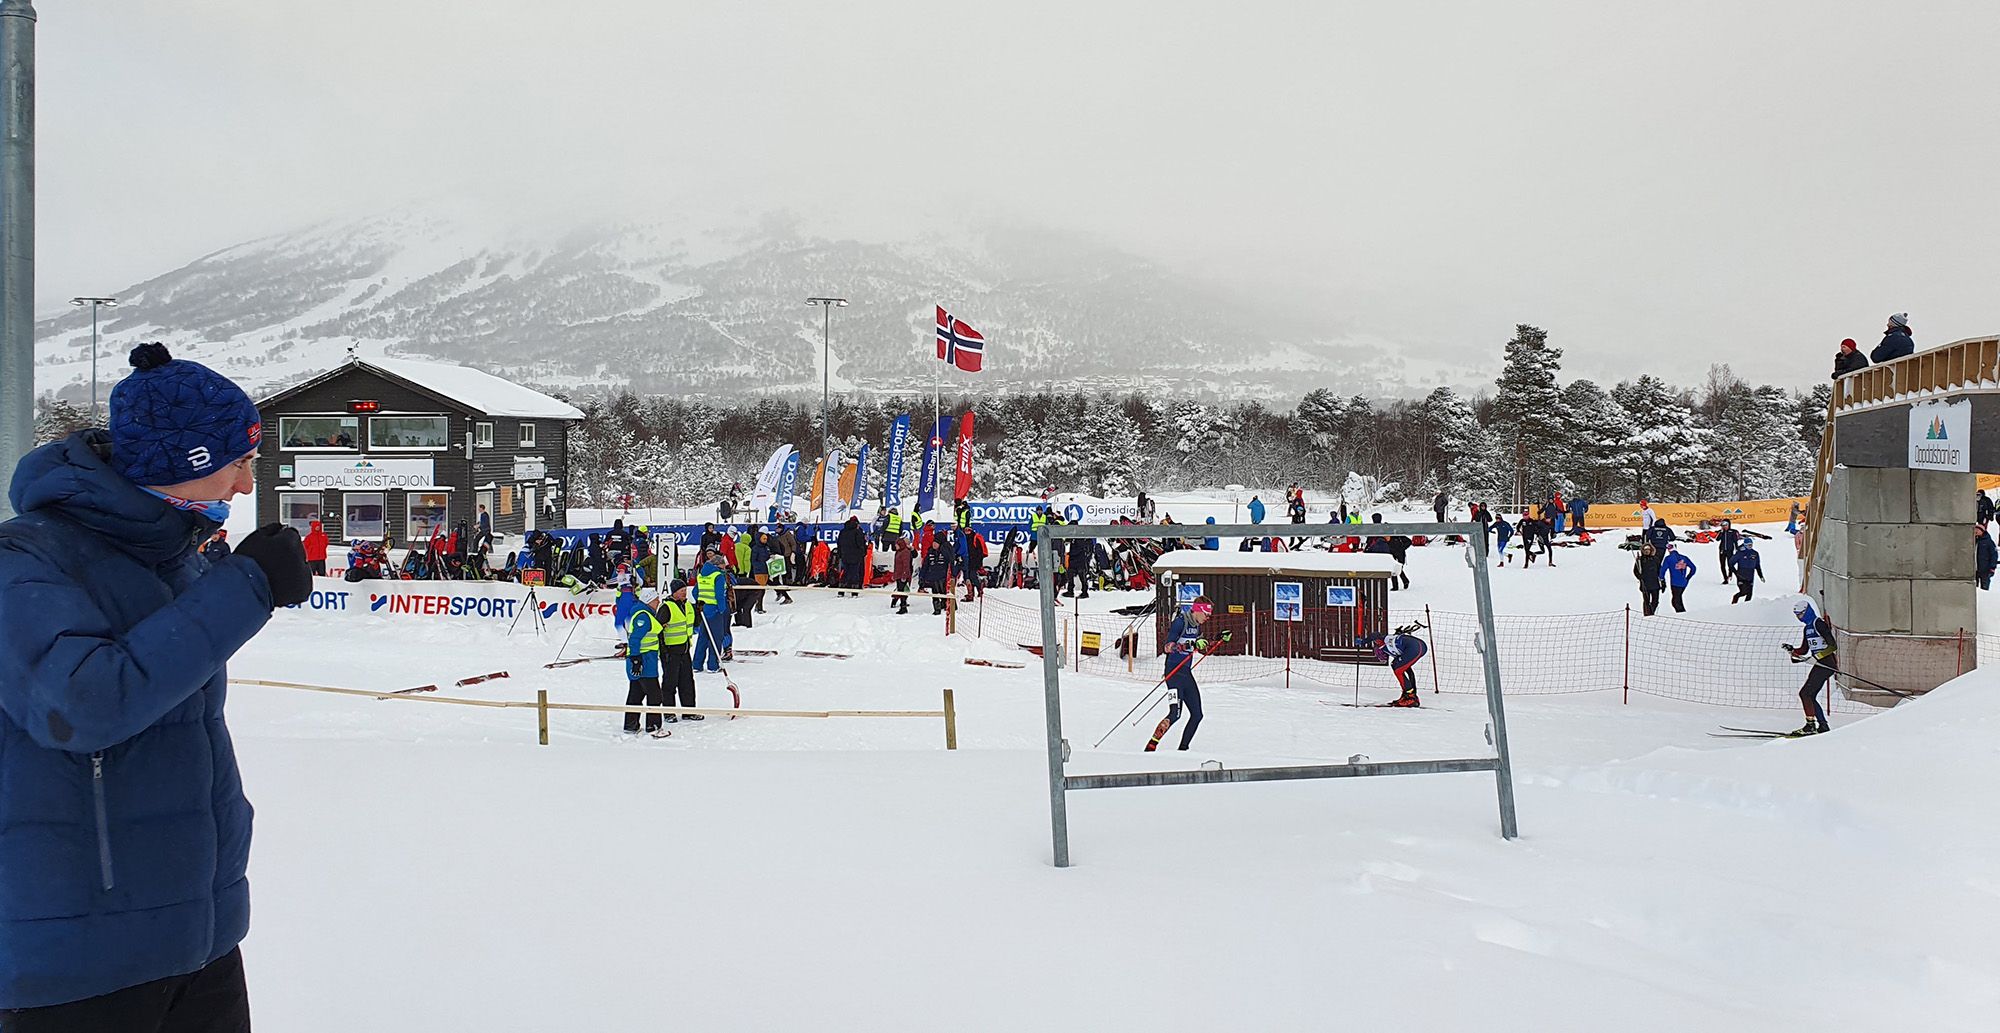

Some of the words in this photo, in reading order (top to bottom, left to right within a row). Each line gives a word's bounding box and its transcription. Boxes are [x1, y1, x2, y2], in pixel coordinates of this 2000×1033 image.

[890, 422, 906, 494] INTERSPORT
[924, 450, 938, 493] SpareBank
[299, 475, 351, 487] OPPDAL
[354, 475, 430, 487] SKISTADION
[1594, 511, 1605, 520] bry
[661, 545, 670, 595] STA
[388, 594, 517, 618] INTERSPORT
